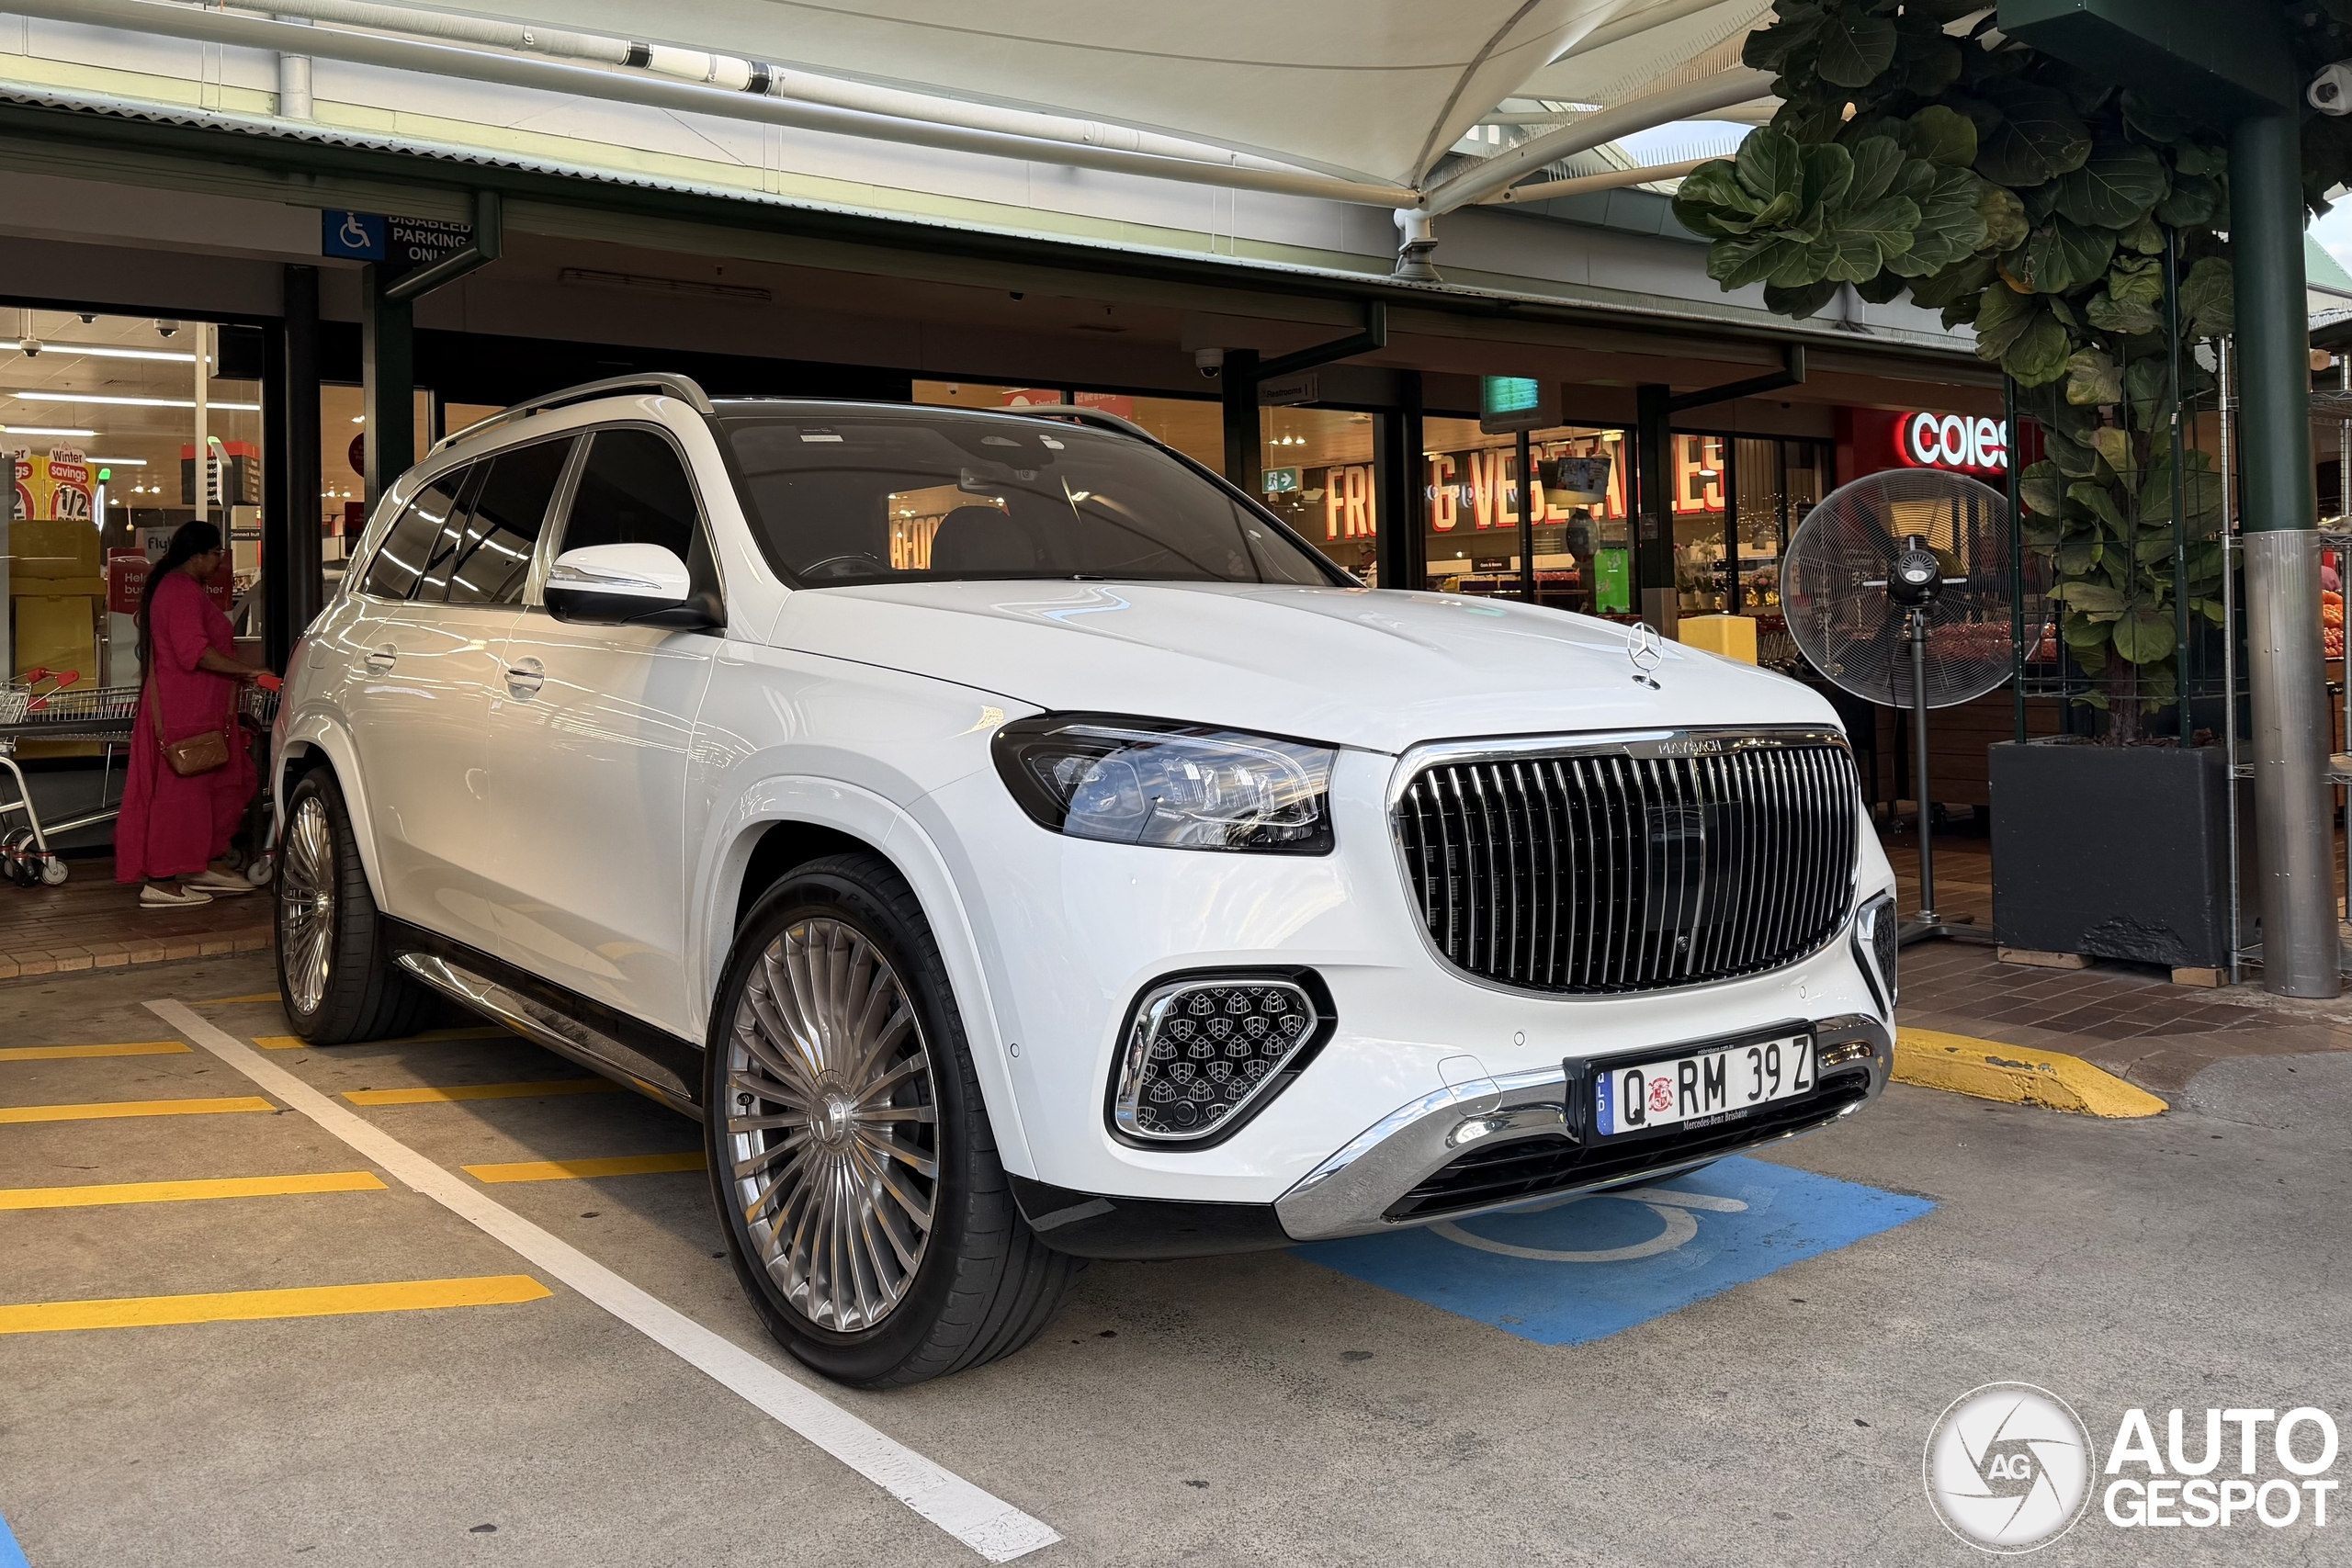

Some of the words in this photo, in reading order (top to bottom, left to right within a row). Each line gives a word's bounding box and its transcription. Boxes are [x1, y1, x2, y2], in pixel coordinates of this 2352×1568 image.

[393, 228, 467, 248] PARKING
[409, 247, 446, 262] ONL
[1267, 388, 1302, 398] Restrooms
[52, 450, 82, 463] Winter
[51, 466, 86, 482] savings
[60, 487, 87, 516] 1/2
[1658, 738, 1722, 754] MAYBACH
[1623, 1069, 1646, 1126] Q
[1679, 1054, 1725, 1117] RM
[1747, 1043, 1781, 1101] 39
[1792, 1035, 1810, 1091] Z
[1683, 1115, 1724, 1131] Mercedes-Benz
[1724, 1110, 1748, 1122] Brisbane
